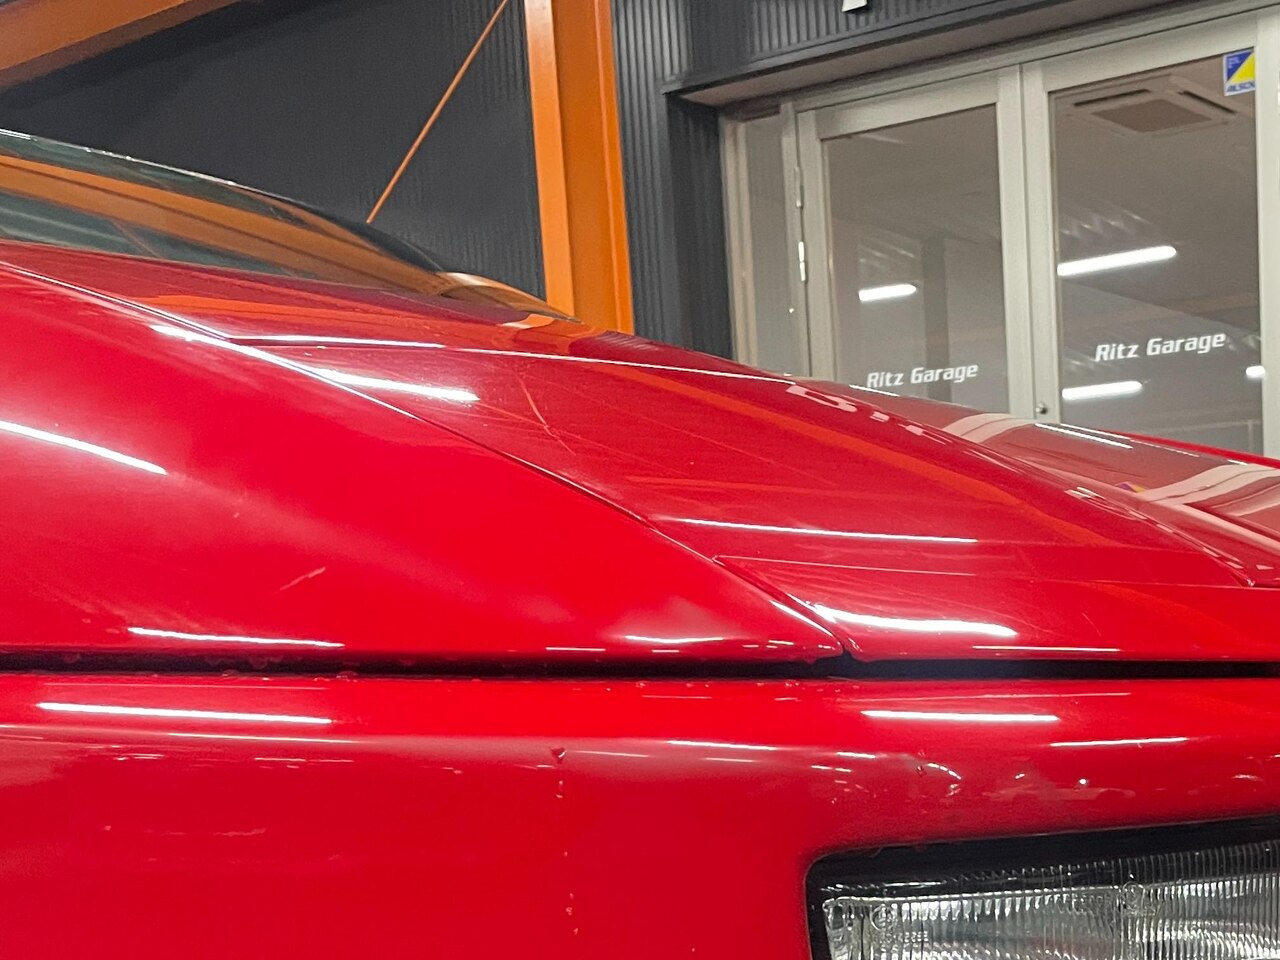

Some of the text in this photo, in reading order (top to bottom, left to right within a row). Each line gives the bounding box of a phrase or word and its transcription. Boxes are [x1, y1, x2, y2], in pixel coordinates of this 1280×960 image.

[1095, 332, 1228, 363] Ritz Garage
[866, 362, 980, 390] Ritz Garage
